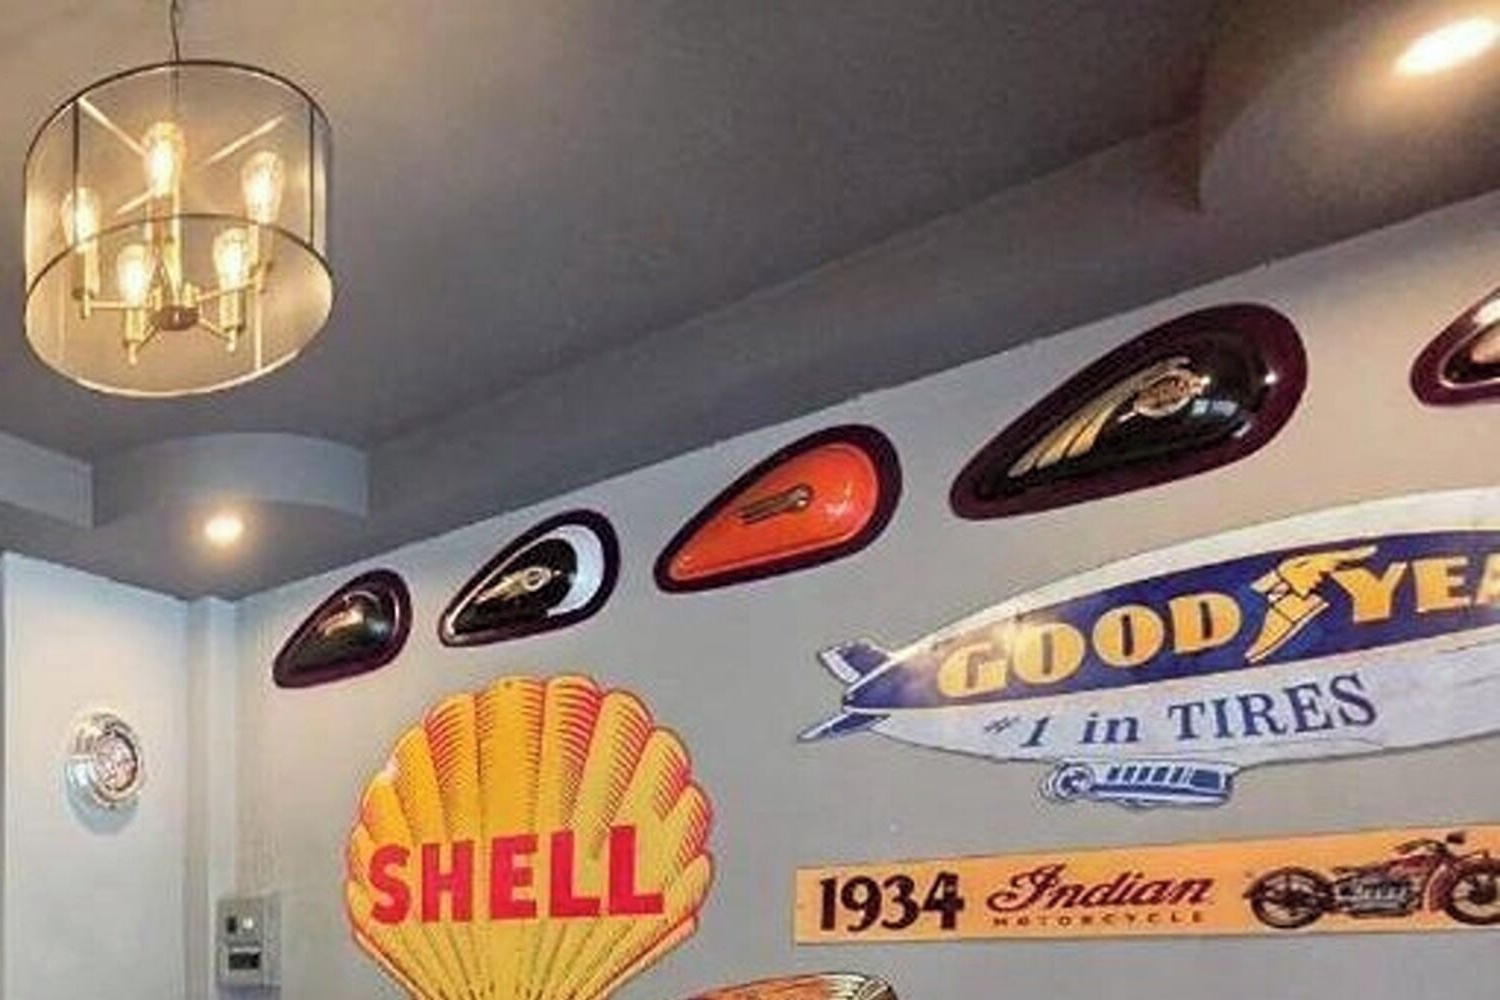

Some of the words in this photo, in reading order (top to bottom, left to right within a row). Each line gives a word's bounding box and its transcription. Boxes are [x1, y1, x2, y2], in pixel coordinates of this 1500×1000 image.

[937, 592, 1242, 698] GOOD
[983, 714, 1050, 748] #1
[1079, 711, 1140, 745] in
[1168, 674, 1377, 741] TIRES
[368, 825, 664, 925] SHELL
[819, 871, 965, 932] 1934
[986, 863, 1214, 913] Indian
[993, 910, 1203, 928] MOTORCYCLE
